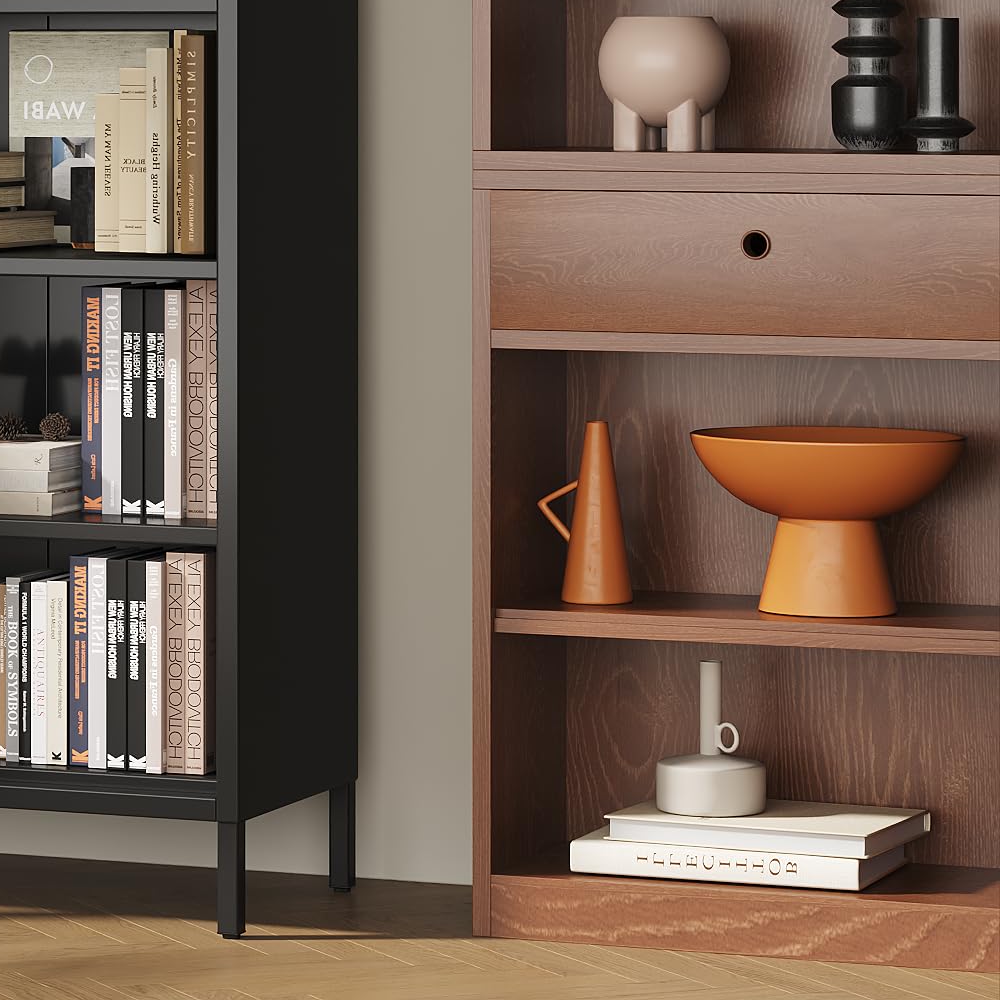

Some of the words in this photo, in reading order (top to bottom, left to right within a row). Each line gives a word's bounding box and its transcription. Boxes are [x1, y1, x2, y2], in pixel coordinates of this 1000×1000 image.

[8, 622, 17, 658] BOOK
[8, 661, 13, 669] OF
[8, 672, 18, 737] SYMBOLS
